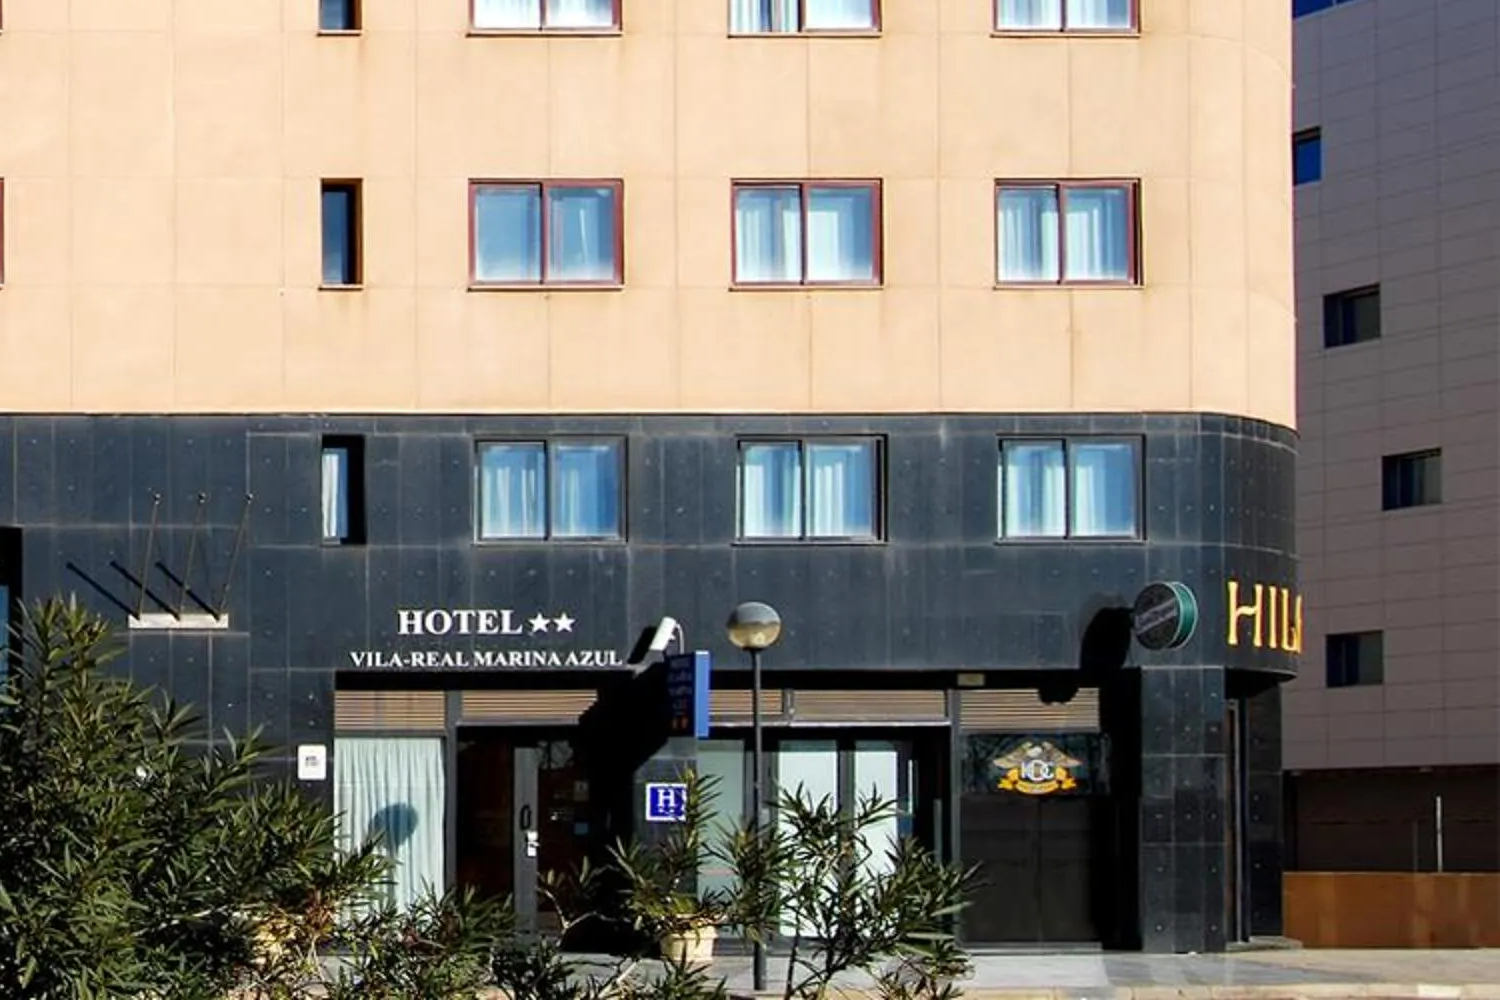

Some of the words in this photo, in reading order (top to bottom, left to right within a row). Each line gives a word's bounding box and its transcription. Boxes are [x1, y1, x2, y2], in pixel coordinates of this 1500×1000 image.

[398, 609, 523, 635] HOTEL
[350, 651, 469, 668] VILA-REAL
[473, 650, 562, 667] MARINA
[564, 650, 623, 667] AZUL
